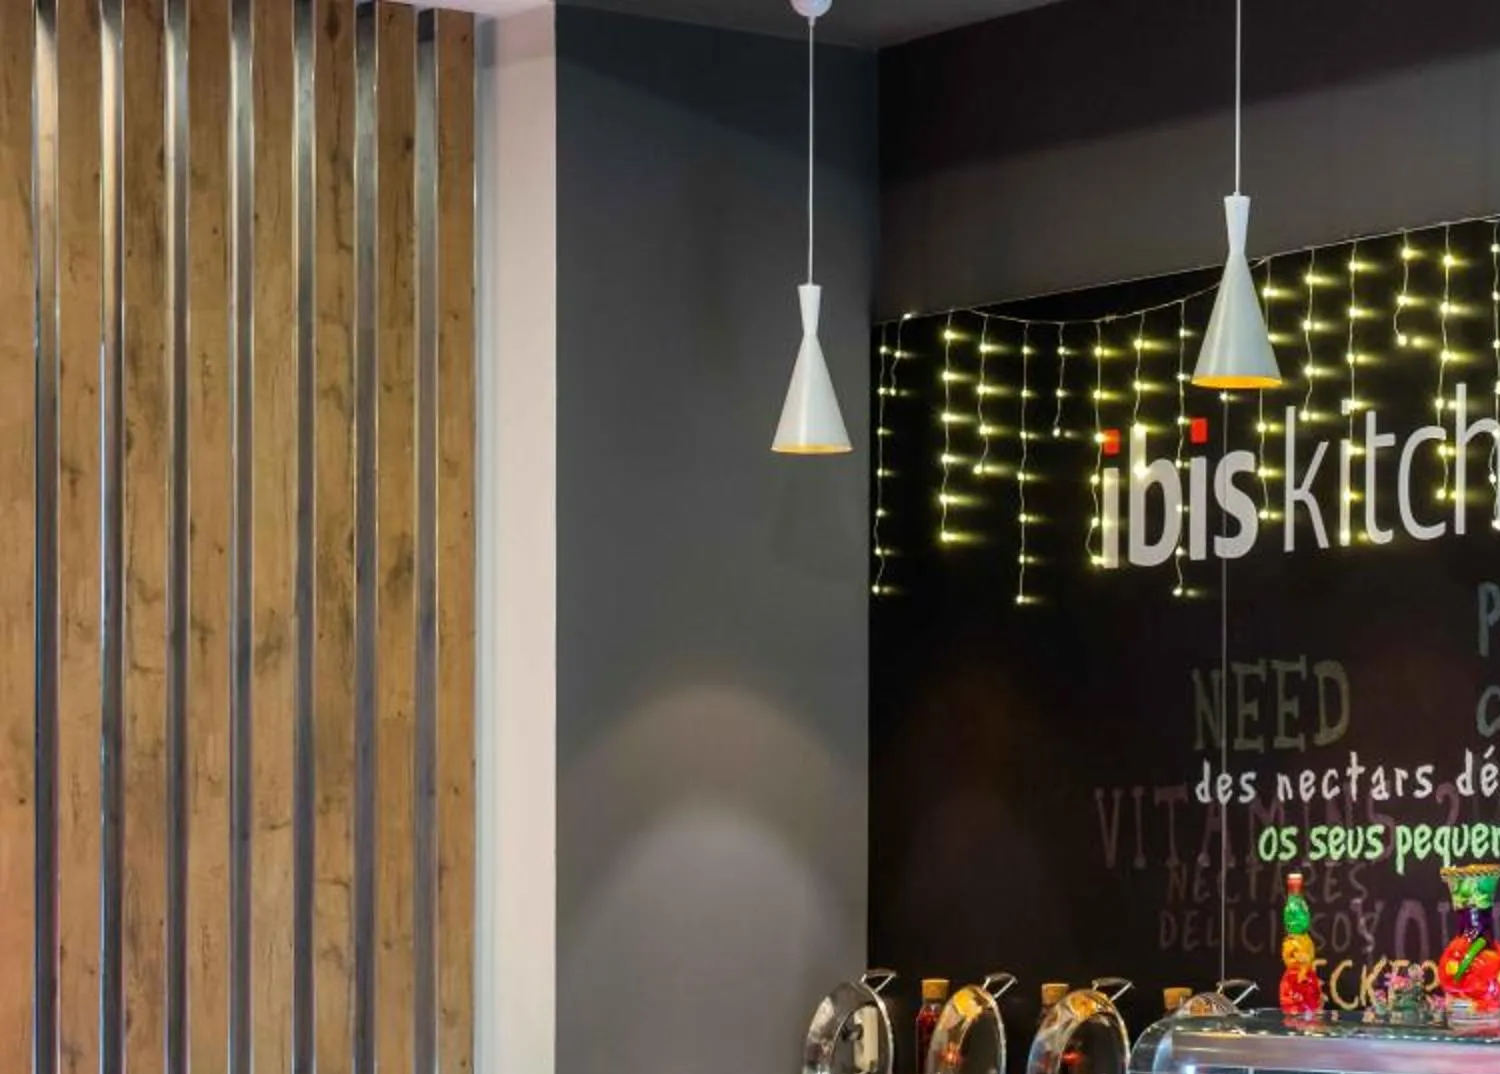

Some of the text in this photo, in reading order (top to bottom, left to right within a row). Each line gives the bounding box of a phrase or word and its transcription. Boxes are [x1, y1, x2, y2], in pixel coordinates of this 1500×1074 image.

[1191, 658, 1352, 753] NEED
[1194, 758, 1258, 805] des
[1276, 750, 1435, 803] nectars
[1257, 824, 1298, 863] os
[1308, 822, 1385, 862] seus
